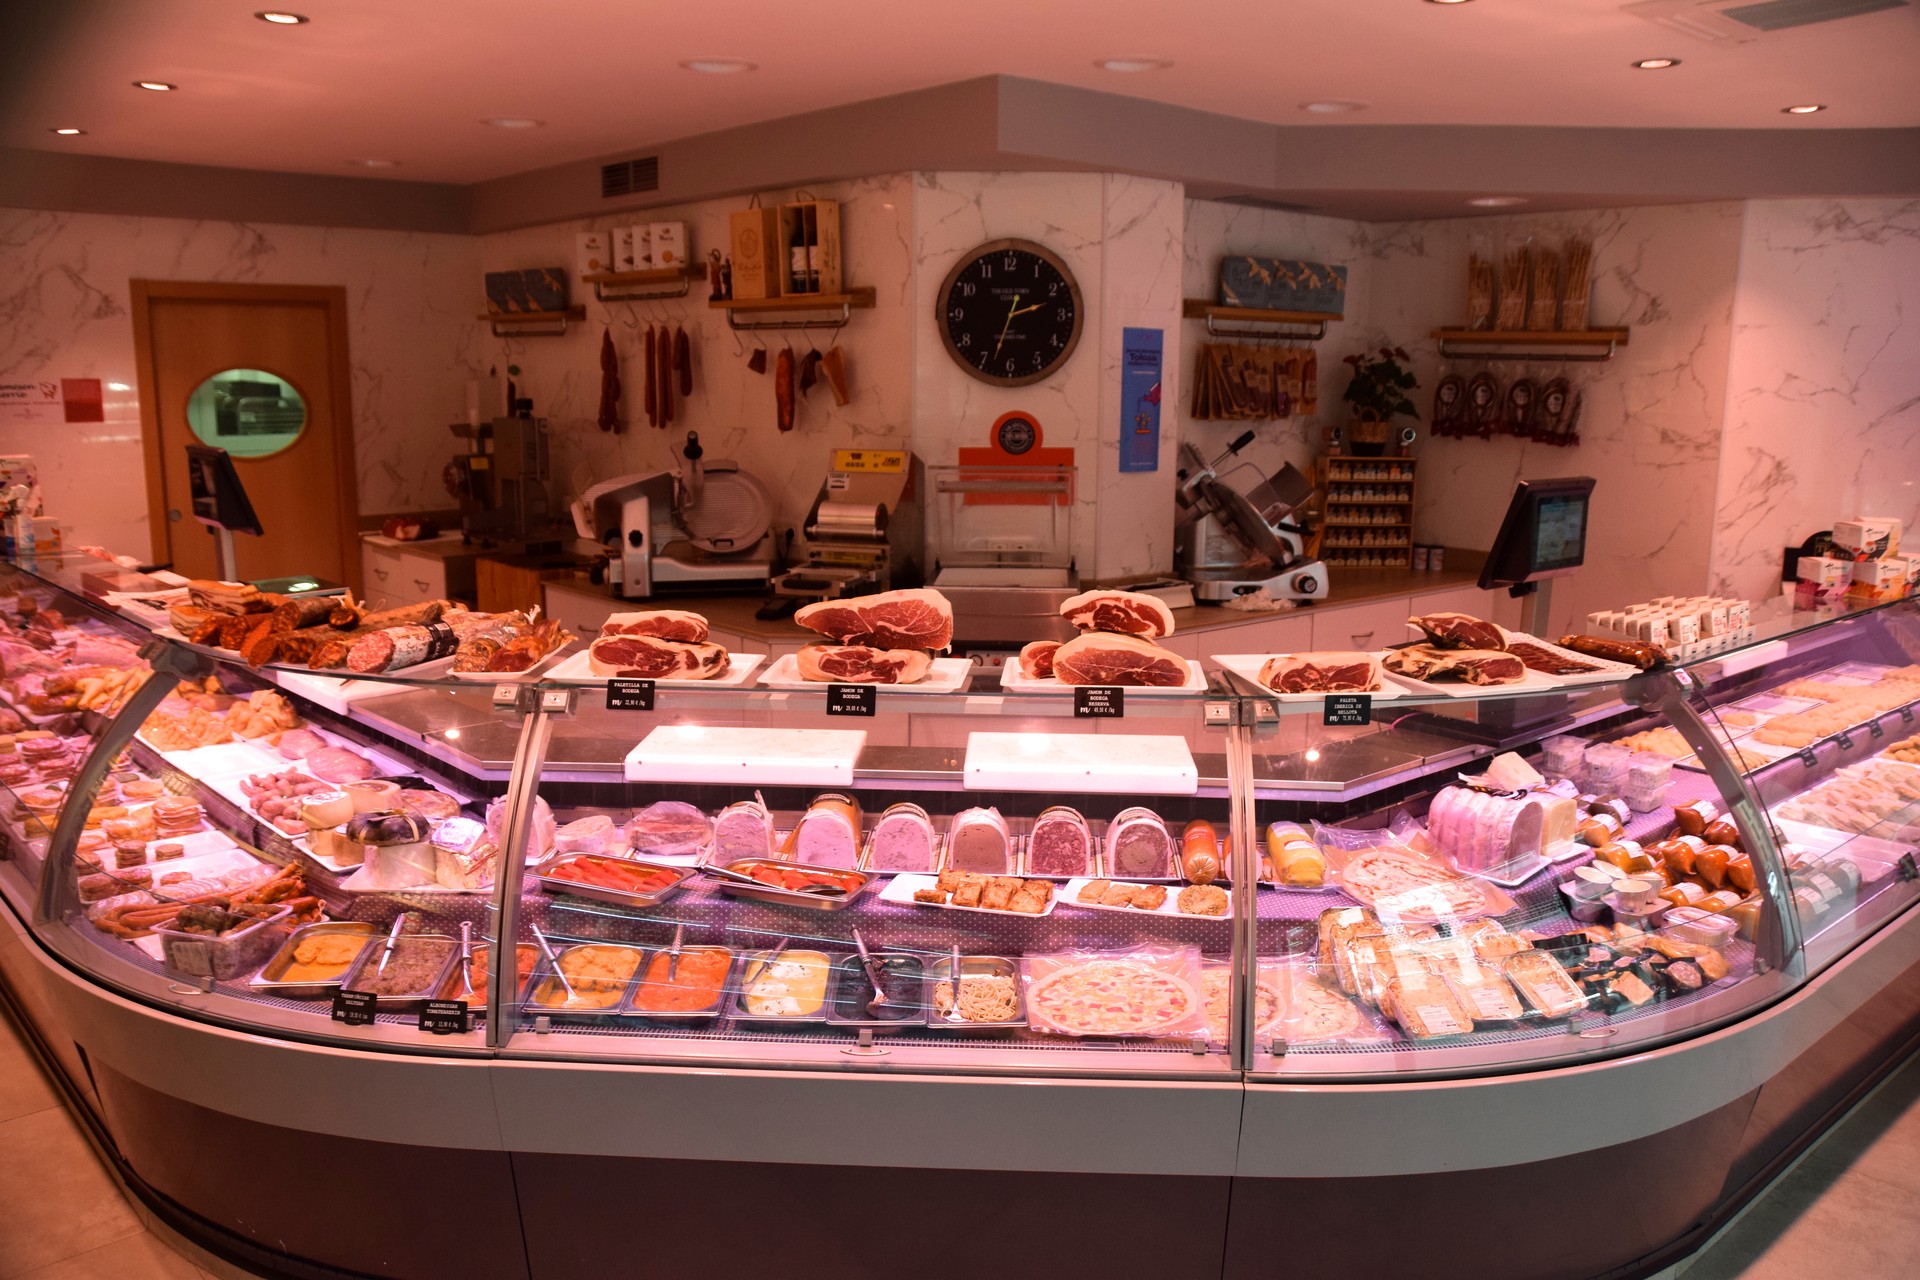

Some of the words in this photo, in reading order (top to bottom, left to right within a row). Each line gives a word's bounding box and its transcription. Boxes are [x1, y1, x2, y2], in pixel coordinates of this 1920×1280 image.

[1004, 257, 1017, 271] 12
[981, 265, 992, 278] 11
[1034, 265, 1039, 278] 1
[963, 282, 976, 296] 10
[1048, 282, 1058, 296] 2
[955, 308, 964, 321] 9
[1057, 308, 1066, 321] 3
[962, 333, 971, 346] 8
[1049, 333, 1058, 346] 4
[980, 351, 988, 365] 7
[1032, 351, 1041, 365] 5
[1130, 353, 1158, 361] Tolosa
[1006, 358, 1015, 371] 6
